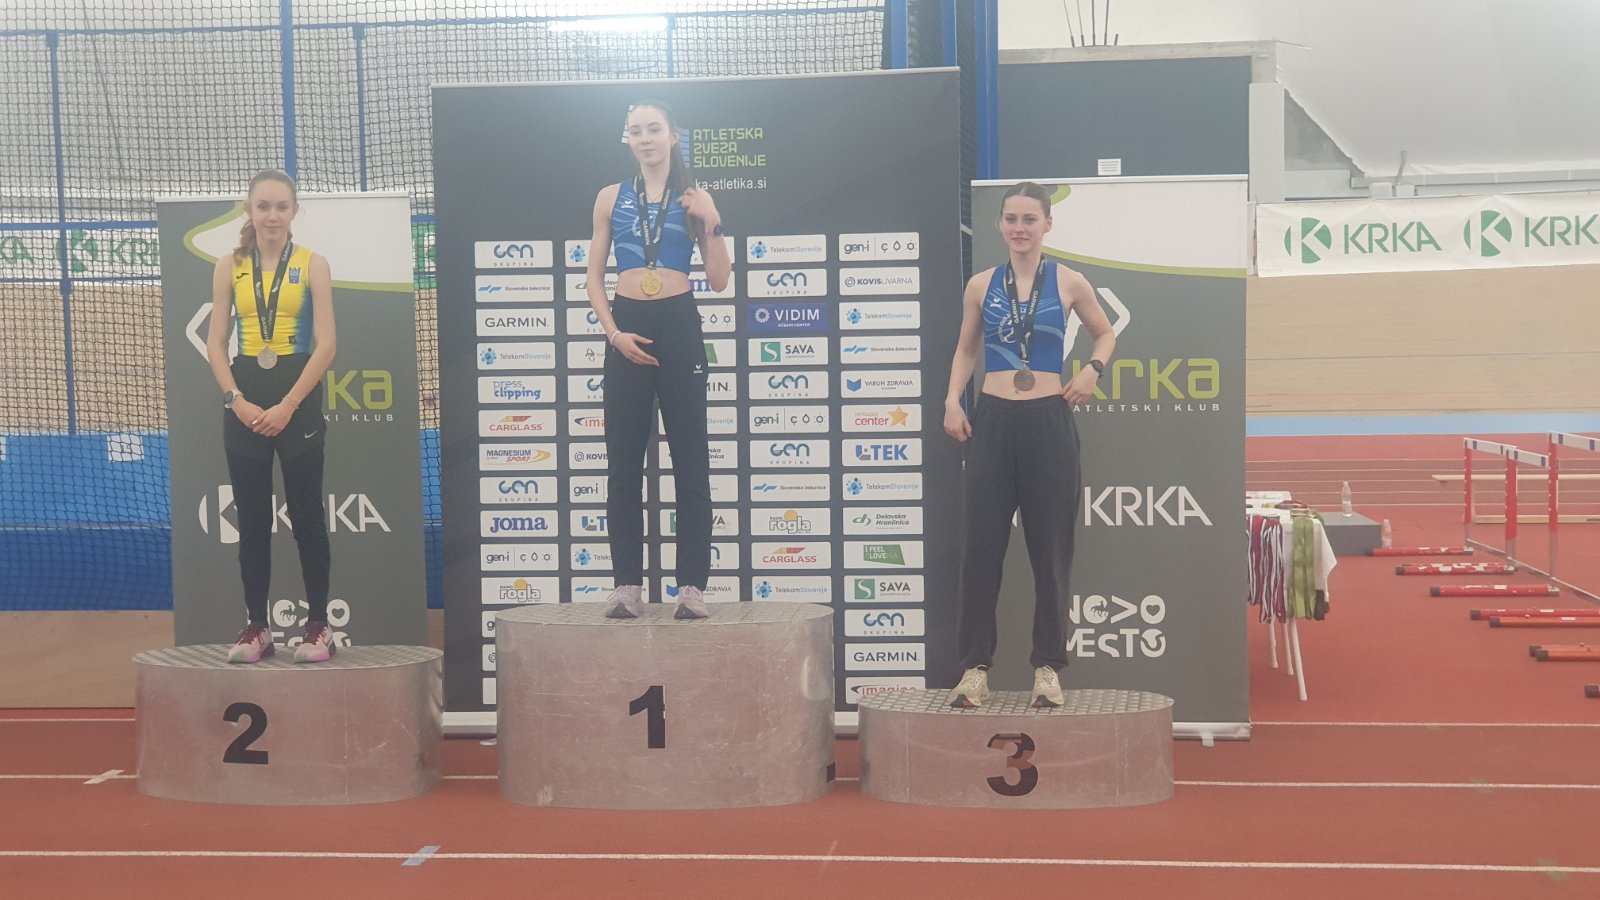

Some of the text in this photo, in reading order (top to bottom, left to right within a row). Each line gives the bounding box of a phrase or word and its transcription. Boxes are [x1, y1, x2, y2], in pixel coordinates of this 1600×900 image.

[693, 127, 763, 140] ATLETSKA
[693, 141, 737, 154] ZVEZA
[693, 154, 766, 168] SLOVENIJE
[695, 177, 767, 190] ka-atletika.si
[1344, 221, 1442, 254] KRKA
[774, 308, 820, 321] VIDIM
[785, 344, 815, 354] SAVA
[494, 387, 541, 400] clipping
[1072, 403, 1220, 412] ATLETSKI KLUB
[352, 414, 393, 422] KLUB
[855, 417, 889, 426] center
[489, 424, 543, 432] CARGLASS
[486, 449, 531, 457] MAGNESIUM
[1084, 486, 1213, 526] KRKA
[769, 516, 811, 534] rogla
[762, 554, 817, 563] CARGLASS
[500, 584, 541, 602] rogla
[880, 582, 911, 592] SAVA
[629, 685, 666, 749] 1
[223, 702, 269, 764] 2
[986, 733, 1038, 796] 3
